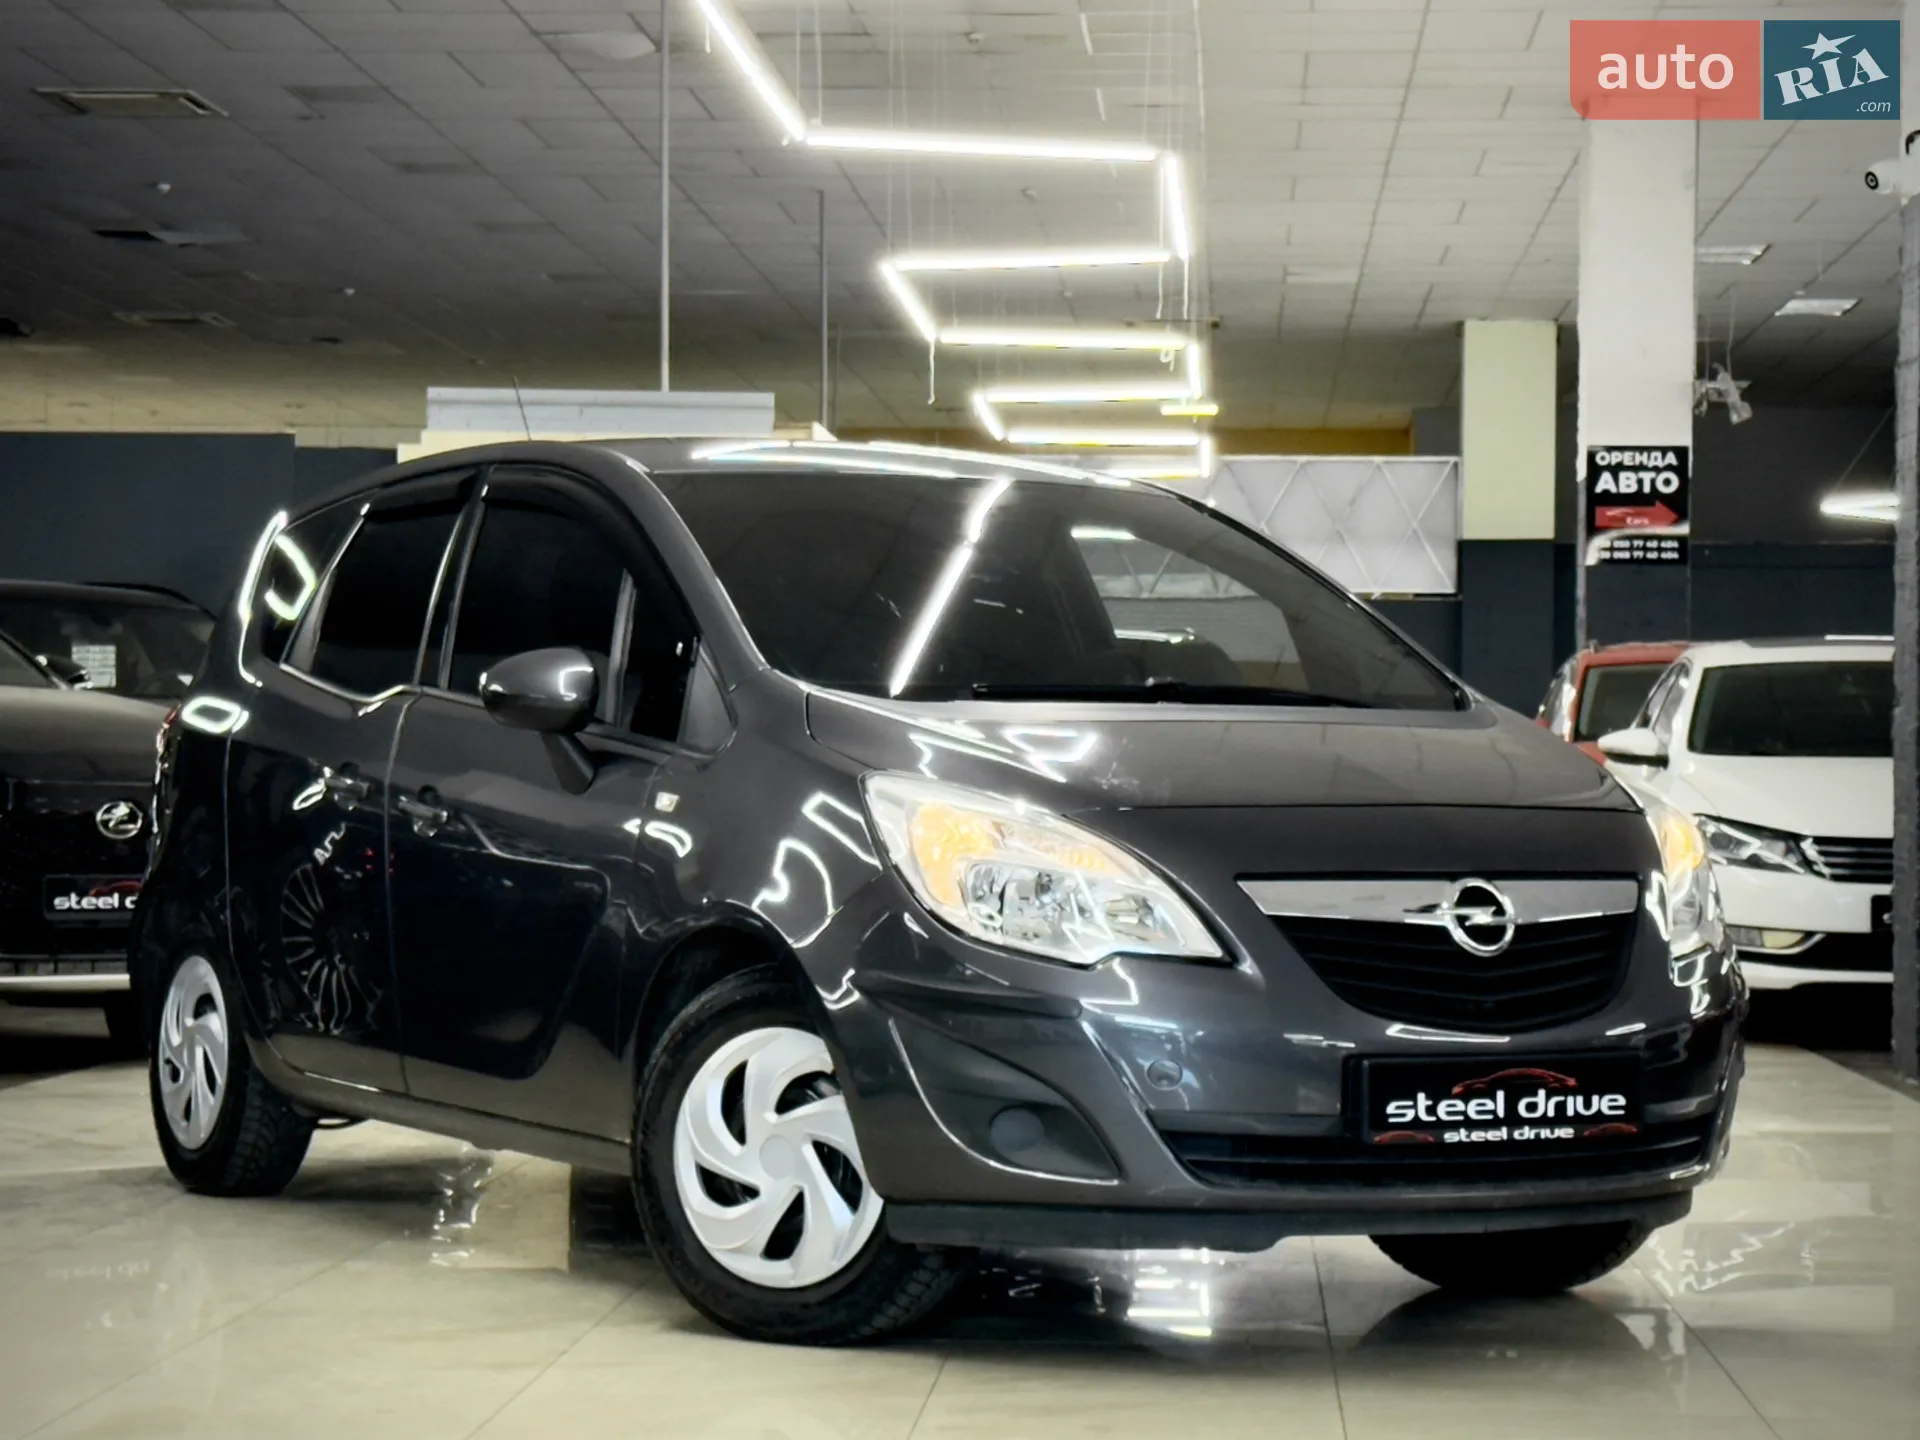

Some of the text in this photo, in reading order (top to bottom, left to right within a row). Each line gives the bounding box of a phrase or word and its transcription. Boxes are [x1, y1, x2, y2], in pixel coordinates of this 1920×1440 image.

[1595, 451, 1679, 468] ОРЕНДА
[1594, 470, 1680, 494] АВТО
[53, 891, 120, 910] steel
[1385, 1088, 1627, 1123] steel drive
[1443, 1125, 1575, 1143] steel drive
